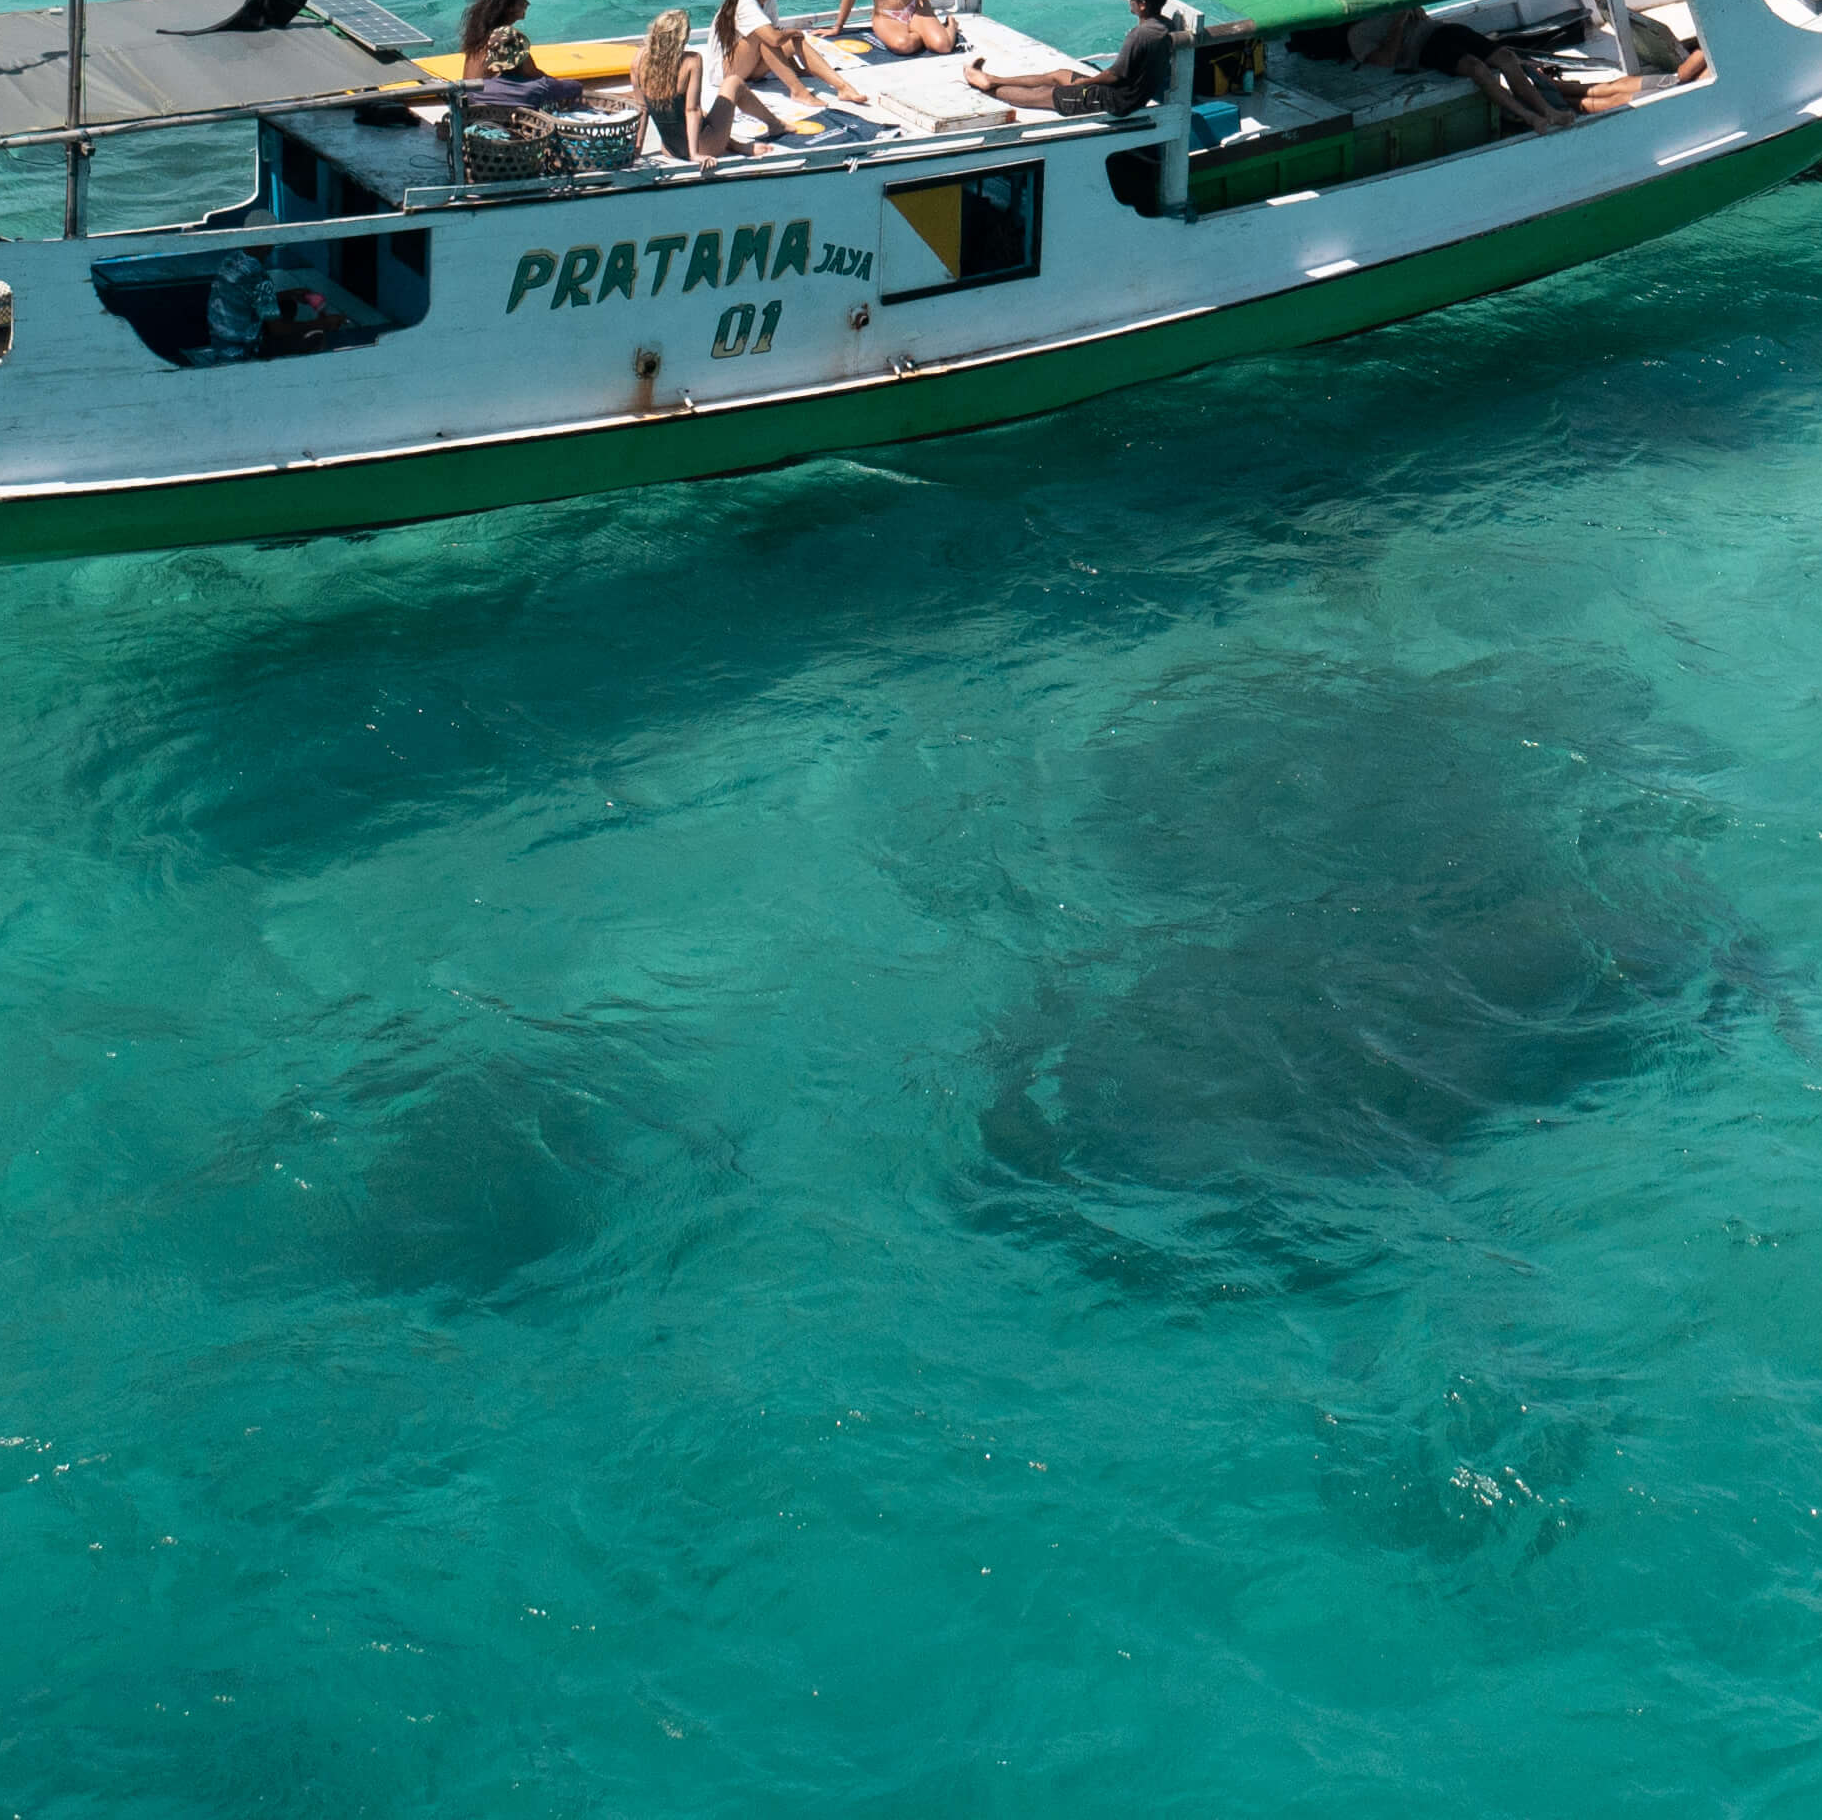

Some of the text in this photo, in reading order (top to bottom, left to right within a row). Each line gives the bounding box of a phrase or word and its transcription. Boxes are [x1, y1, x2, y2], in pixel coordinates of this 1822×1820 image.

[506, 218, 874, 314] PRATAMA JAYA
[711, 300, 782, 359] 01
